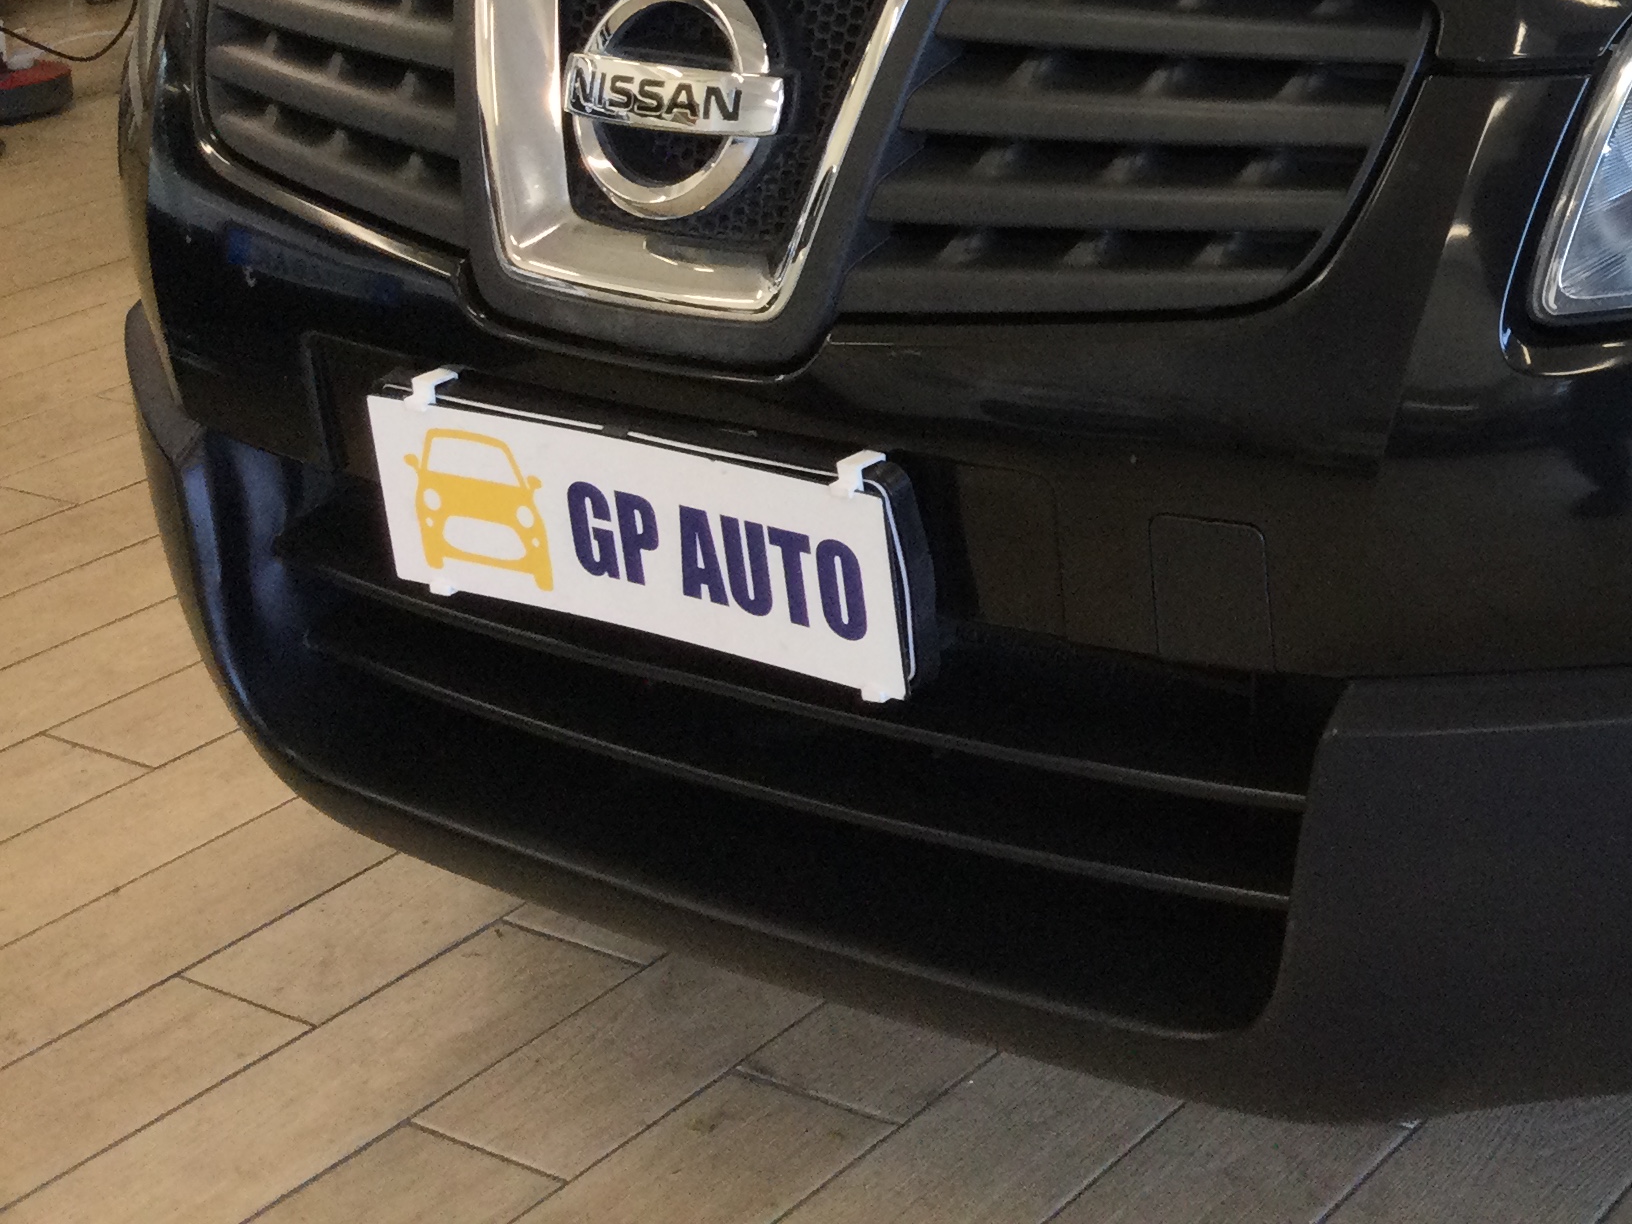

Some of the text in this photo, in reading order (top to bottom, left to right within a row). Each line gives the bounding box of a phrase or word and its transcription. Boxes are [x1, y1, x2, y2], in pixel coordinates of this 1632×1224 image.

[570, 62, 743, 122] NISSAN
[567, 481, 867, 641] GP AUTO
